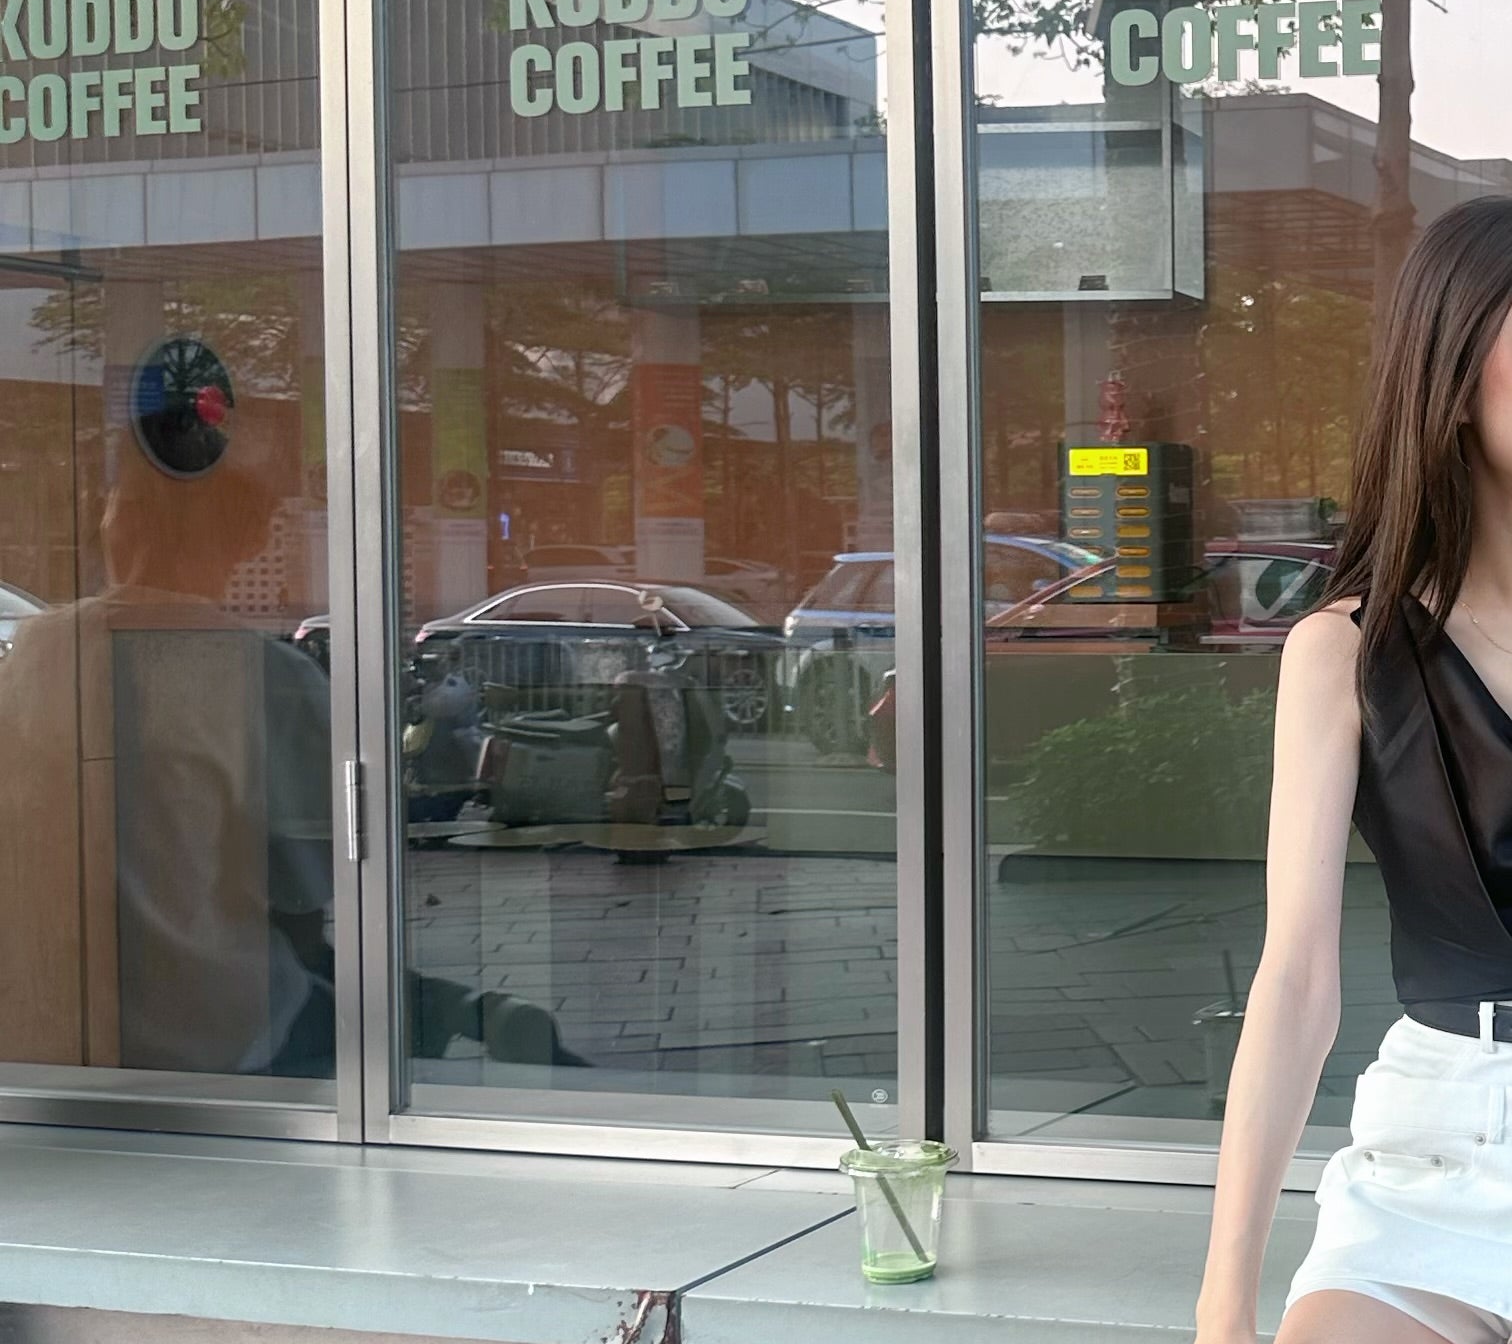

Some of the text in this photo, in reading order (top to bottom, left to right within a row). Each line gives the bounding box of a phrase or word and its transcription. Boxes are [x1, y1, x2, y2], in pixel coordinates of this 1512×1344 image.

[510, 32, 752, 118] COFFEE
[1109, 0, 1382, 86] COFFEE
[0, 64, 200, 144] COFFEE
